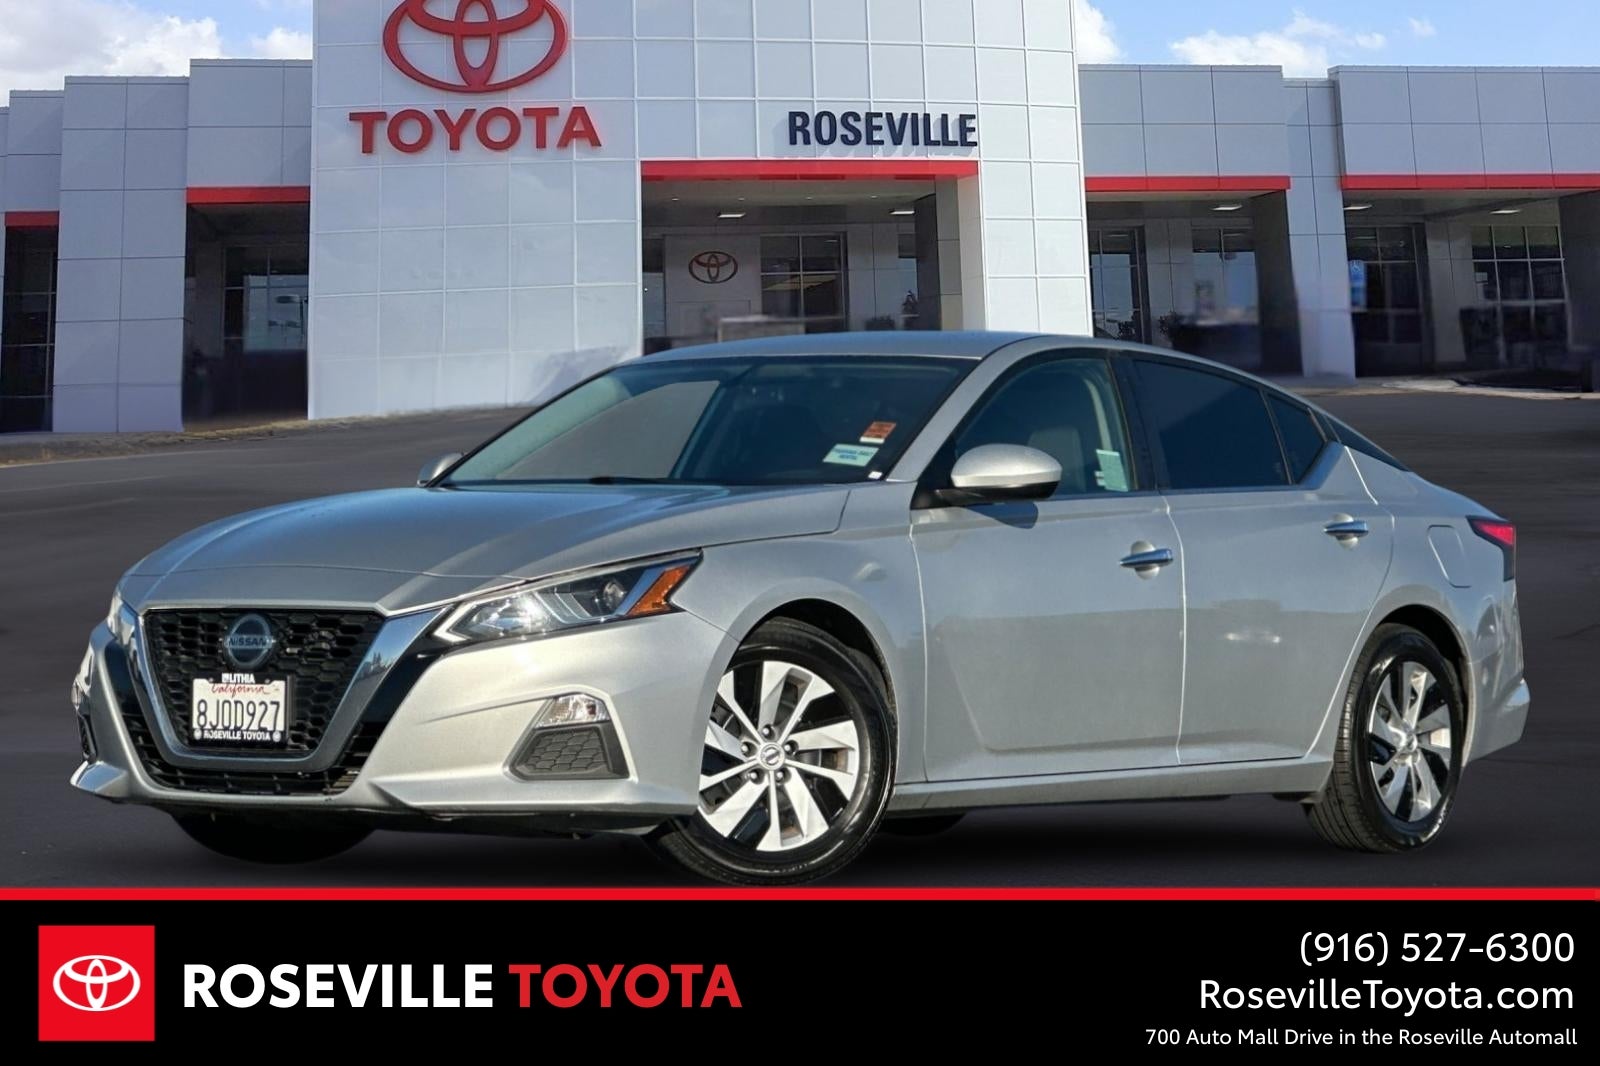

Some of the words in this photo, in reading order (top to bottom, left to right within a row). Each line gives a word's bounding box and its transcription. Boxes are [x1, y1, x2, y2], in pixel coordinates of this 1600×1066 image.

[349, 106, 602, 154] TOYOTA
[788, 110, 978, 147] ROSEVILLE
[227, 637, 267, 647] NISSAN
[230, 673, 255, 684] LITHIA
[212, 682, 271, 698] California
[203, 730, 241, 740] ROSEVILLE
[242, 731, 271, 741] TOYOTA
